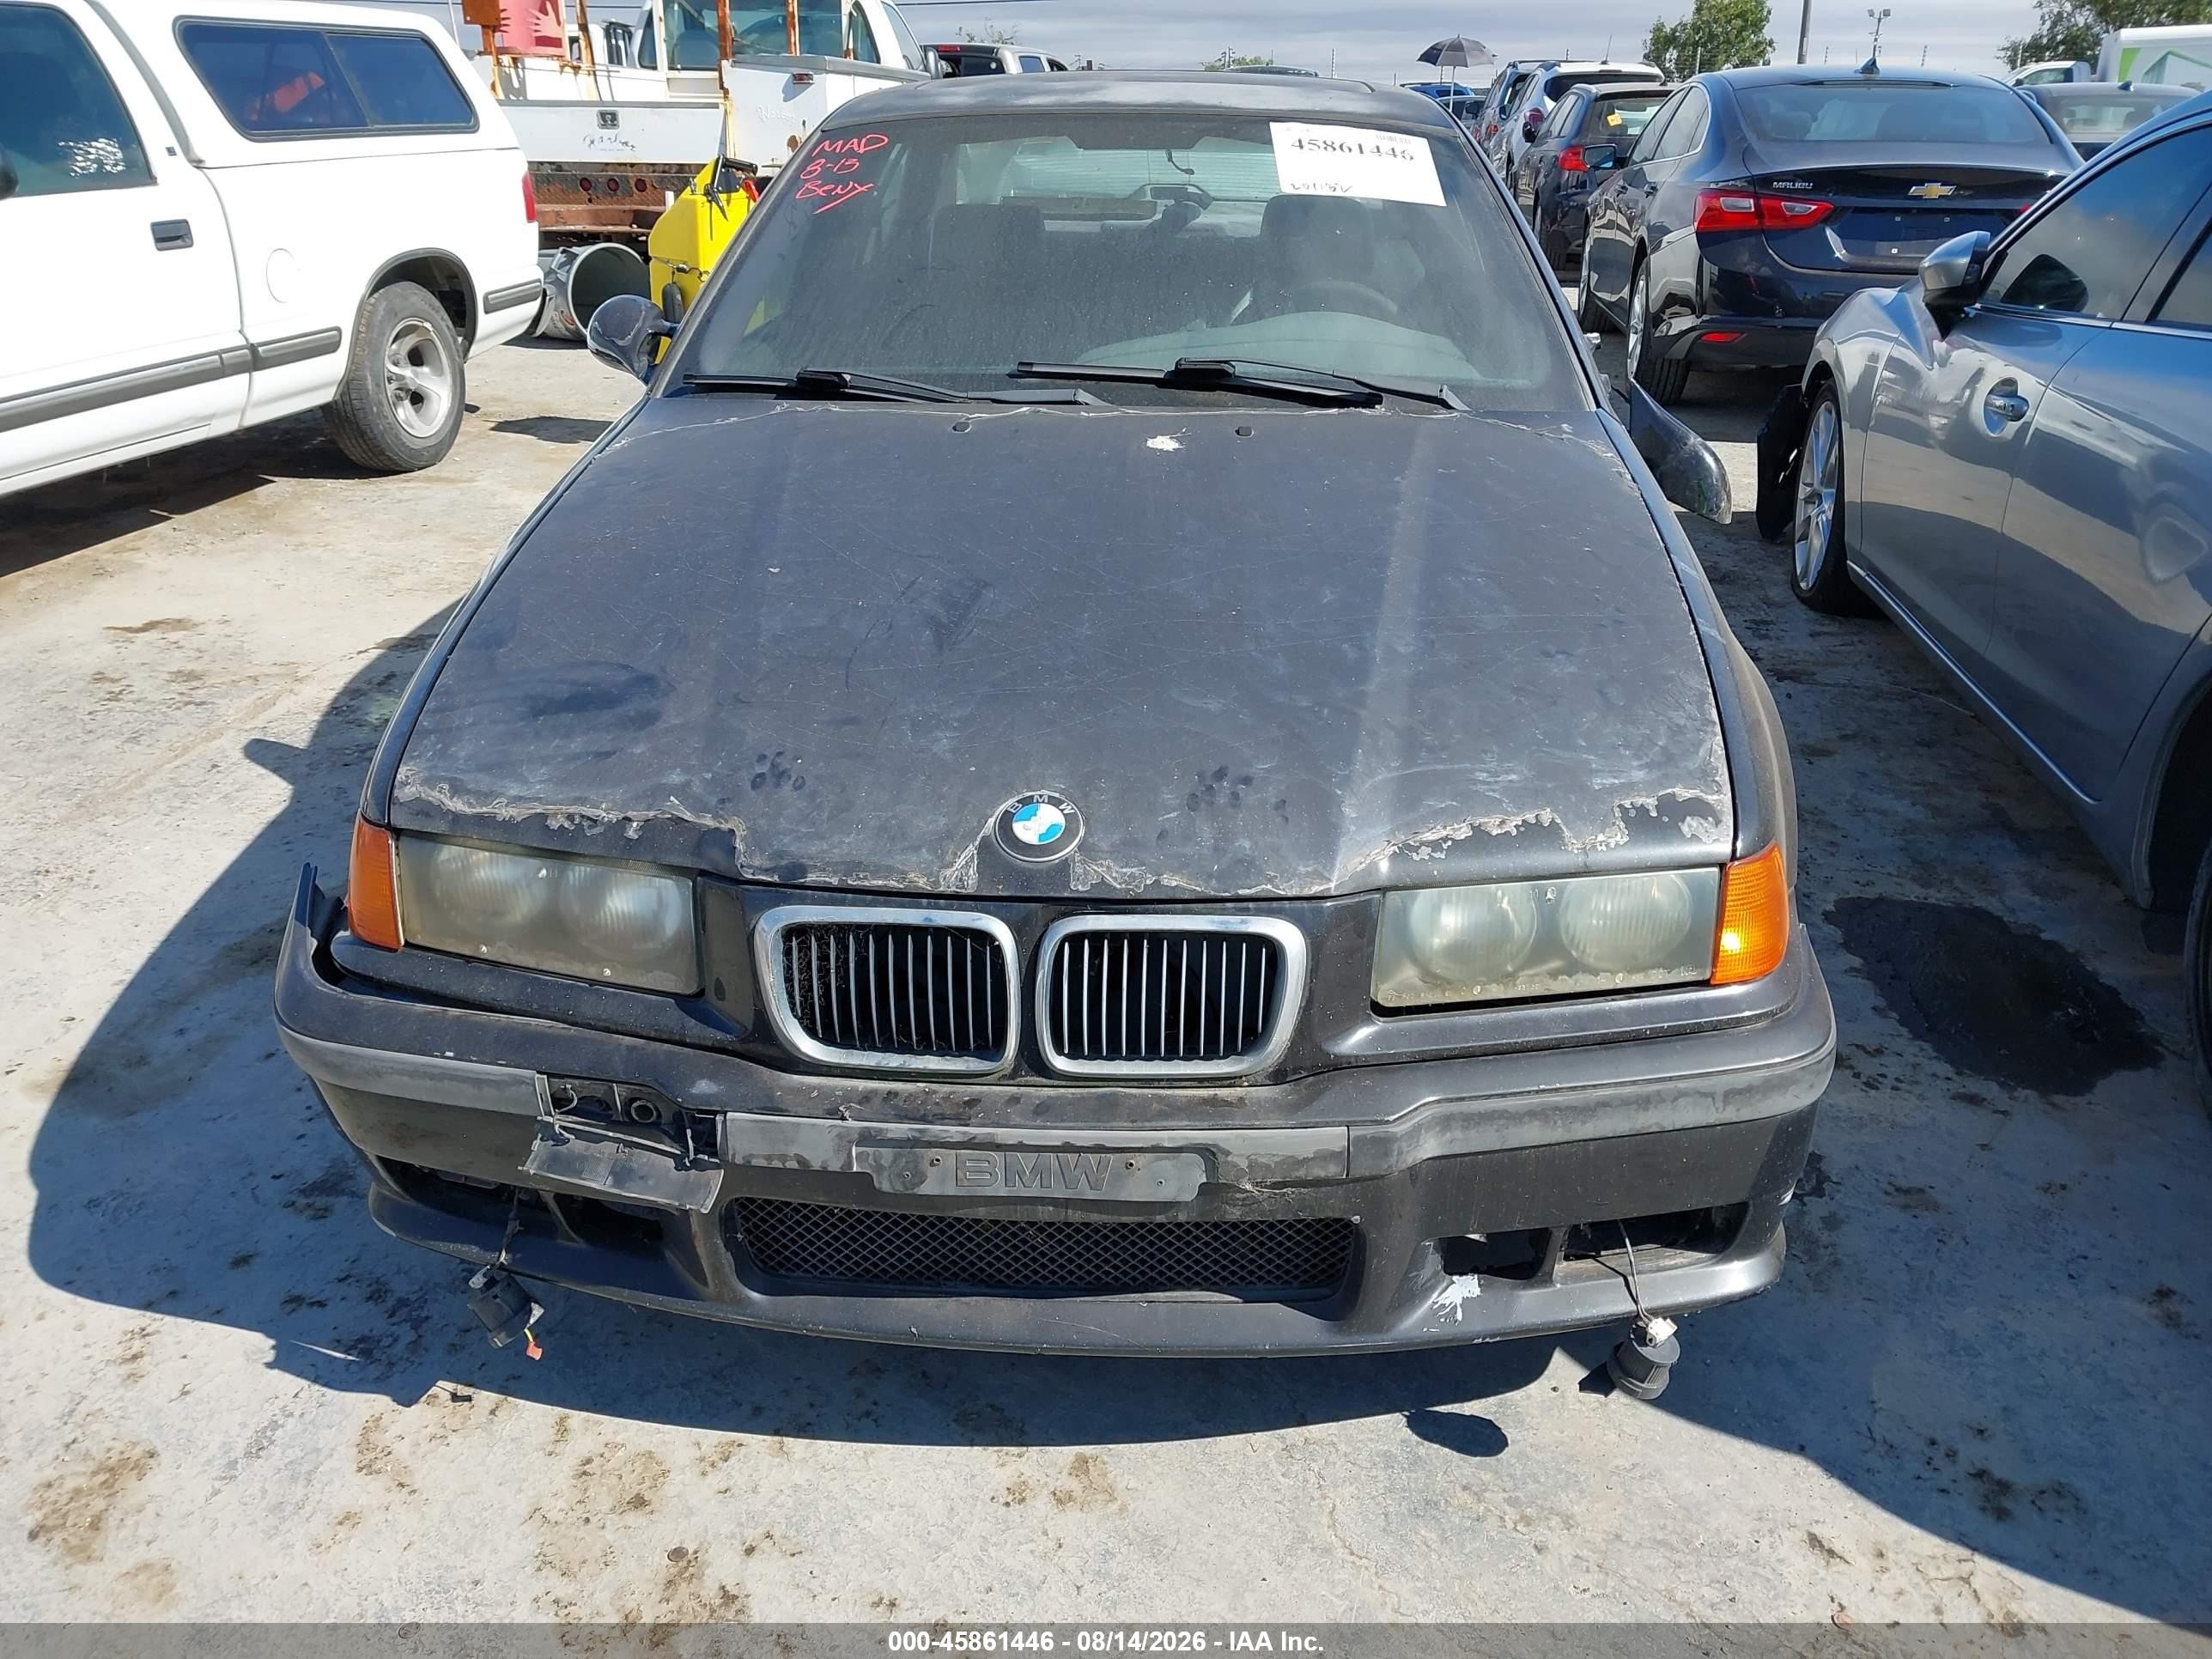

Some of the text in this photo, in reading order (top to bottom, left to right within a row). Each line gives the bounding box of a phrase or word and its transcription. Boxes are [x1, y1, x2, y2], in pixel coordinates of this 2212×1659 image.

[811, 133, 889, 157] MAD
[1291, 137, 1415, 162] 45861446
[1006, 794, 1075, 814] BMW
[956, 1150, 1114, 1191] BMW
